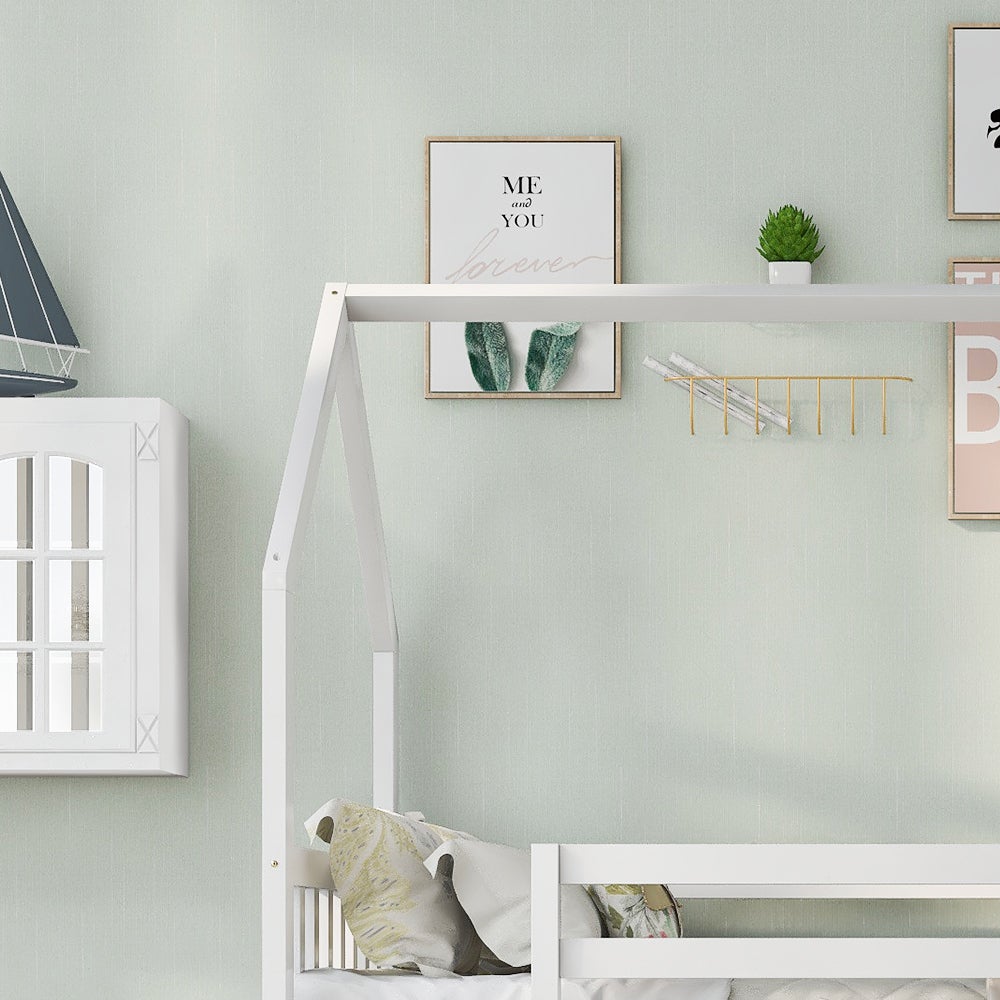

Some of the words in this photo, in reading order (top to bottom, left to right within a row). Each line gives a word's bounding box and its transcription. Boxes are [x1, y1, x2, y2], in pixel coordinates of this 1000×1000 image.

[502, 175, 543, 195] ME
[511, 197, 533, 208] and
[501, 213, 544, 229] YOU
